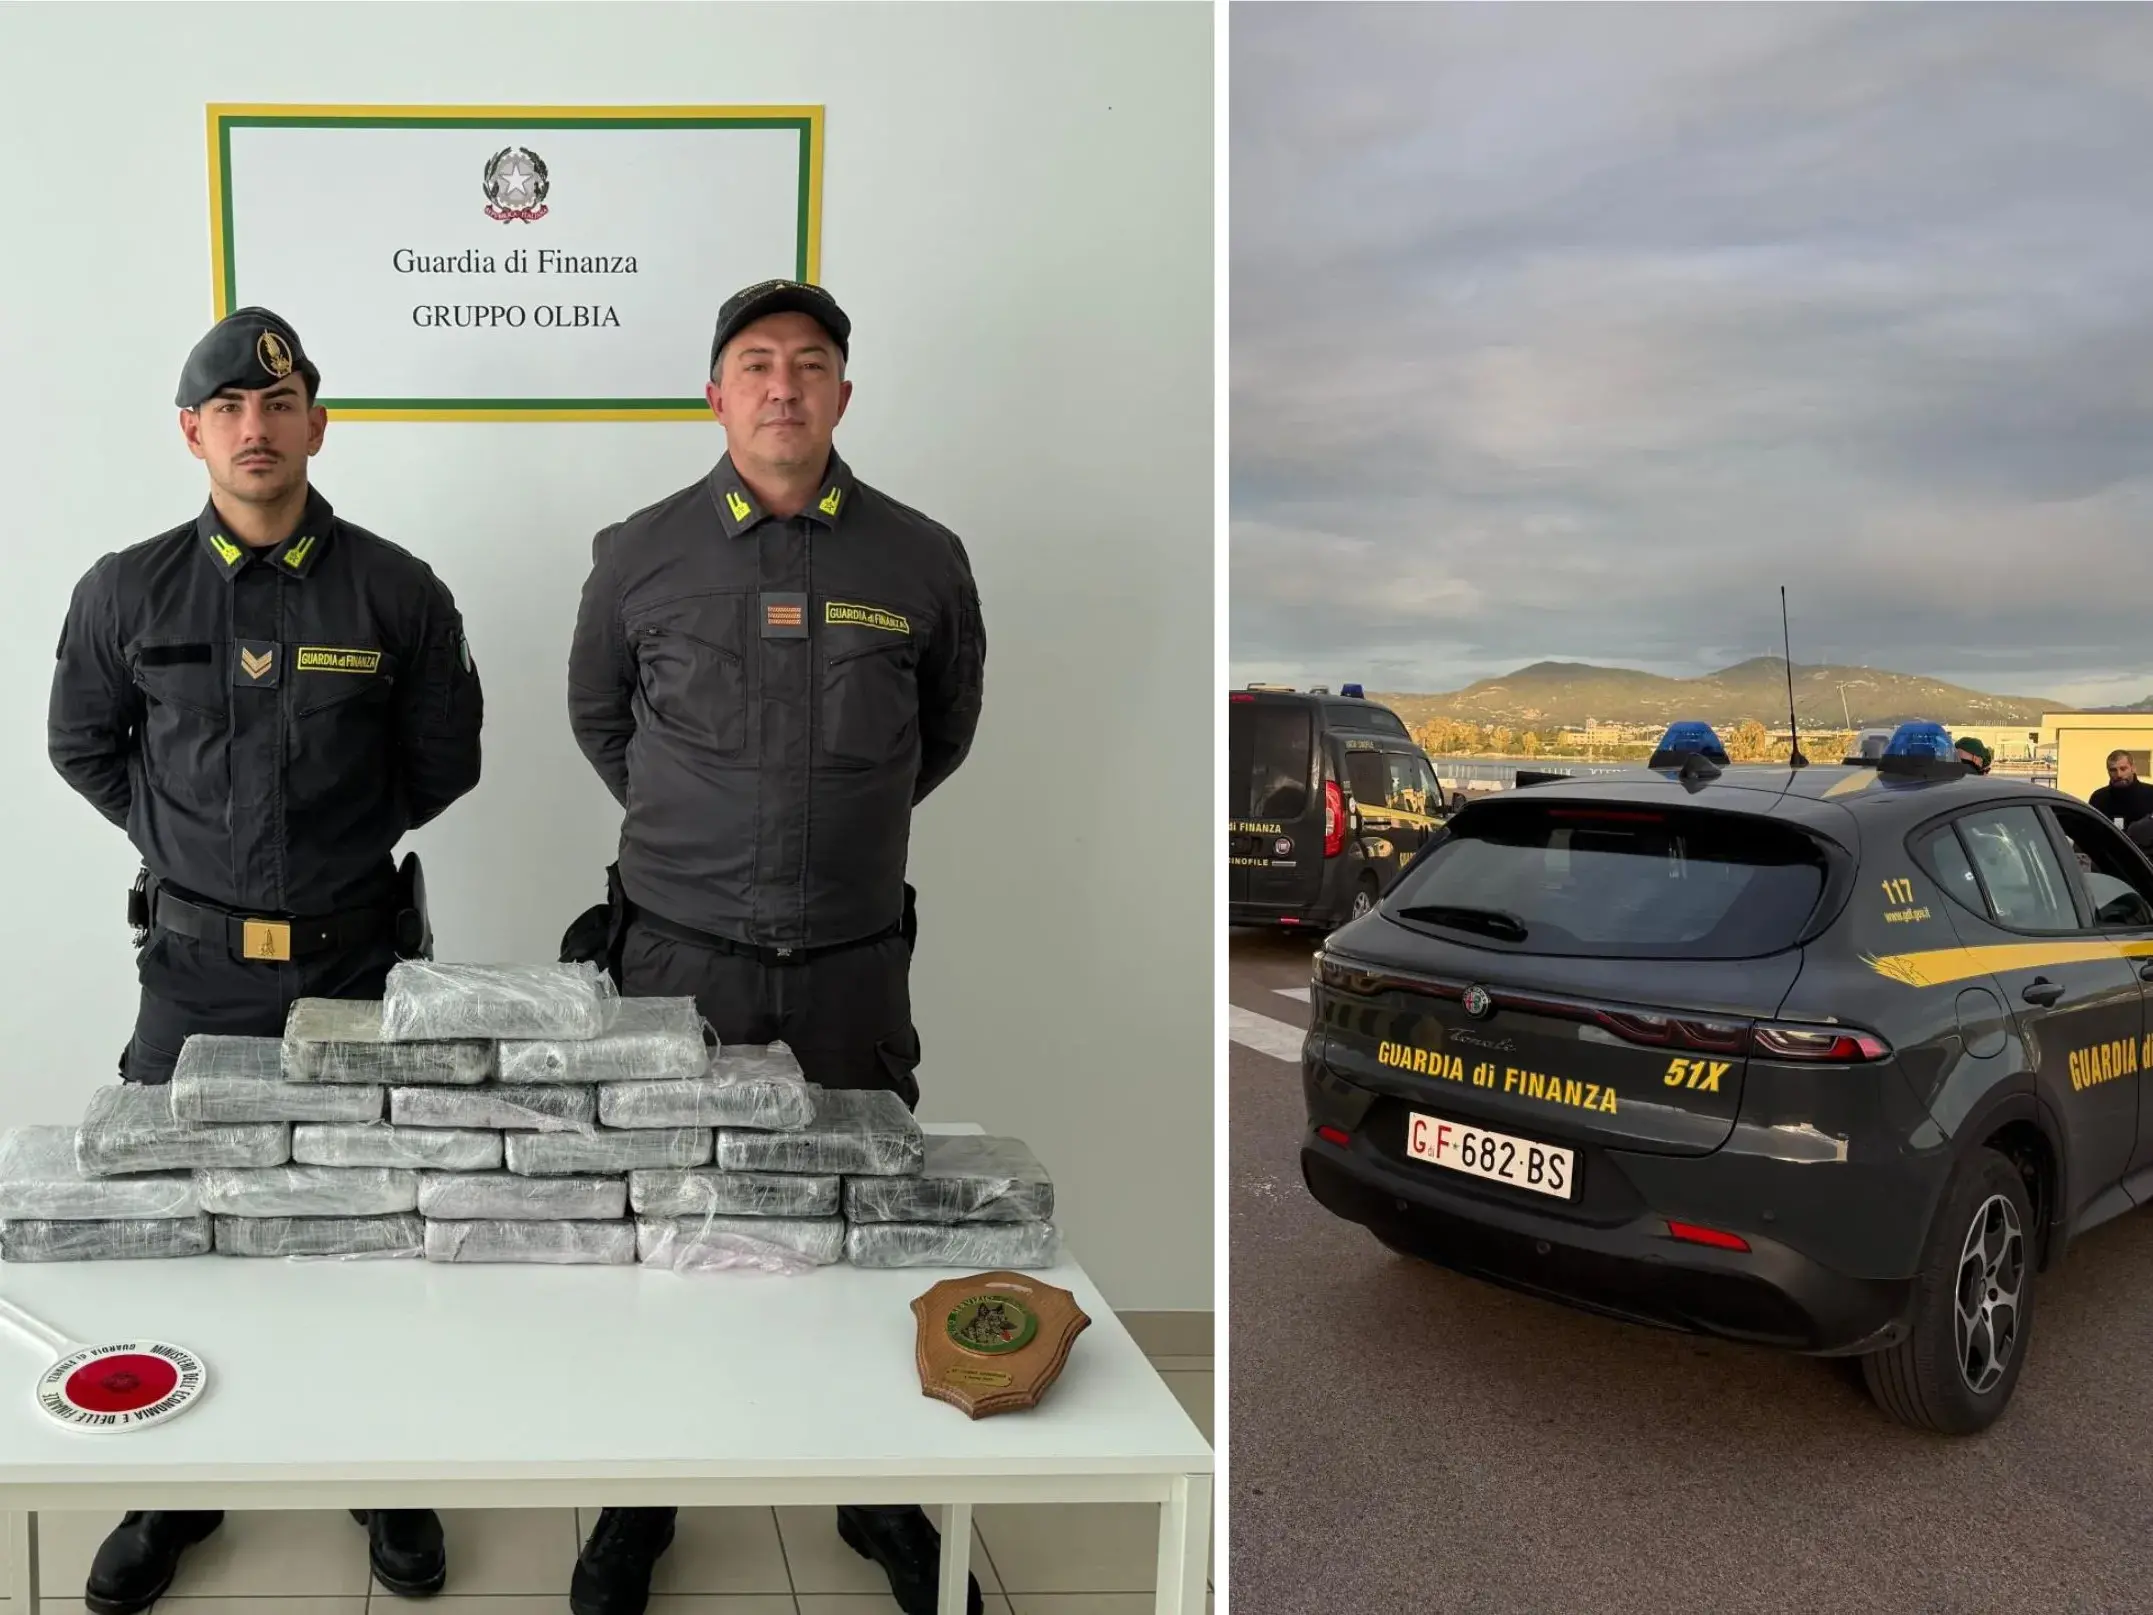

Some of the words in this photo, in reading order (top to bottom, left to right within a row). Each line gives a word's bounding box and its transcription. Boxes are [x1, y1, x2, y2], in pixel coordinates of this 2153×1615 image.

[392, 248, 496, 273] Guardia
[504, 249, 528, 273] di
[537, 249, 638, 273] Finanza
[412, 305, 526, 327] GRUPPO
[534, 305, 621, 327] OLBIA
[829, 607, 866, 621] GUARDIA
[301, 652, 338, 666] GUARDIA
[346, 655, 375, 668] FINANZA
[1240, 822, 1282, 833] FINANZA
[1229, 857, 1268, 866] INOFILE
[1881, 878, 1914, 904] 117
[1663, 1057, 1733, 1093] 51X
[2069, 1036, 2138, 1092] GUARDIA
[1378, 1040, 1464, 1083] GUARDIA
[1472, 1061, 1496, 1089] di
[1504, 1067, 1617, 1114] FINANZA
[91, 1343, 136, 1357] GUARDIA
[150, 1344, 198, 1372] MINISTERO
[47, 1358, 78, 1384] FINANZA
[42, 1392, 76, 1419] FINANZE
[123, 1413, 130, 1423] E
[134, 1390, 191, 1421] ECONOMIA
[75, 1413, 116, 1425] DELLE
